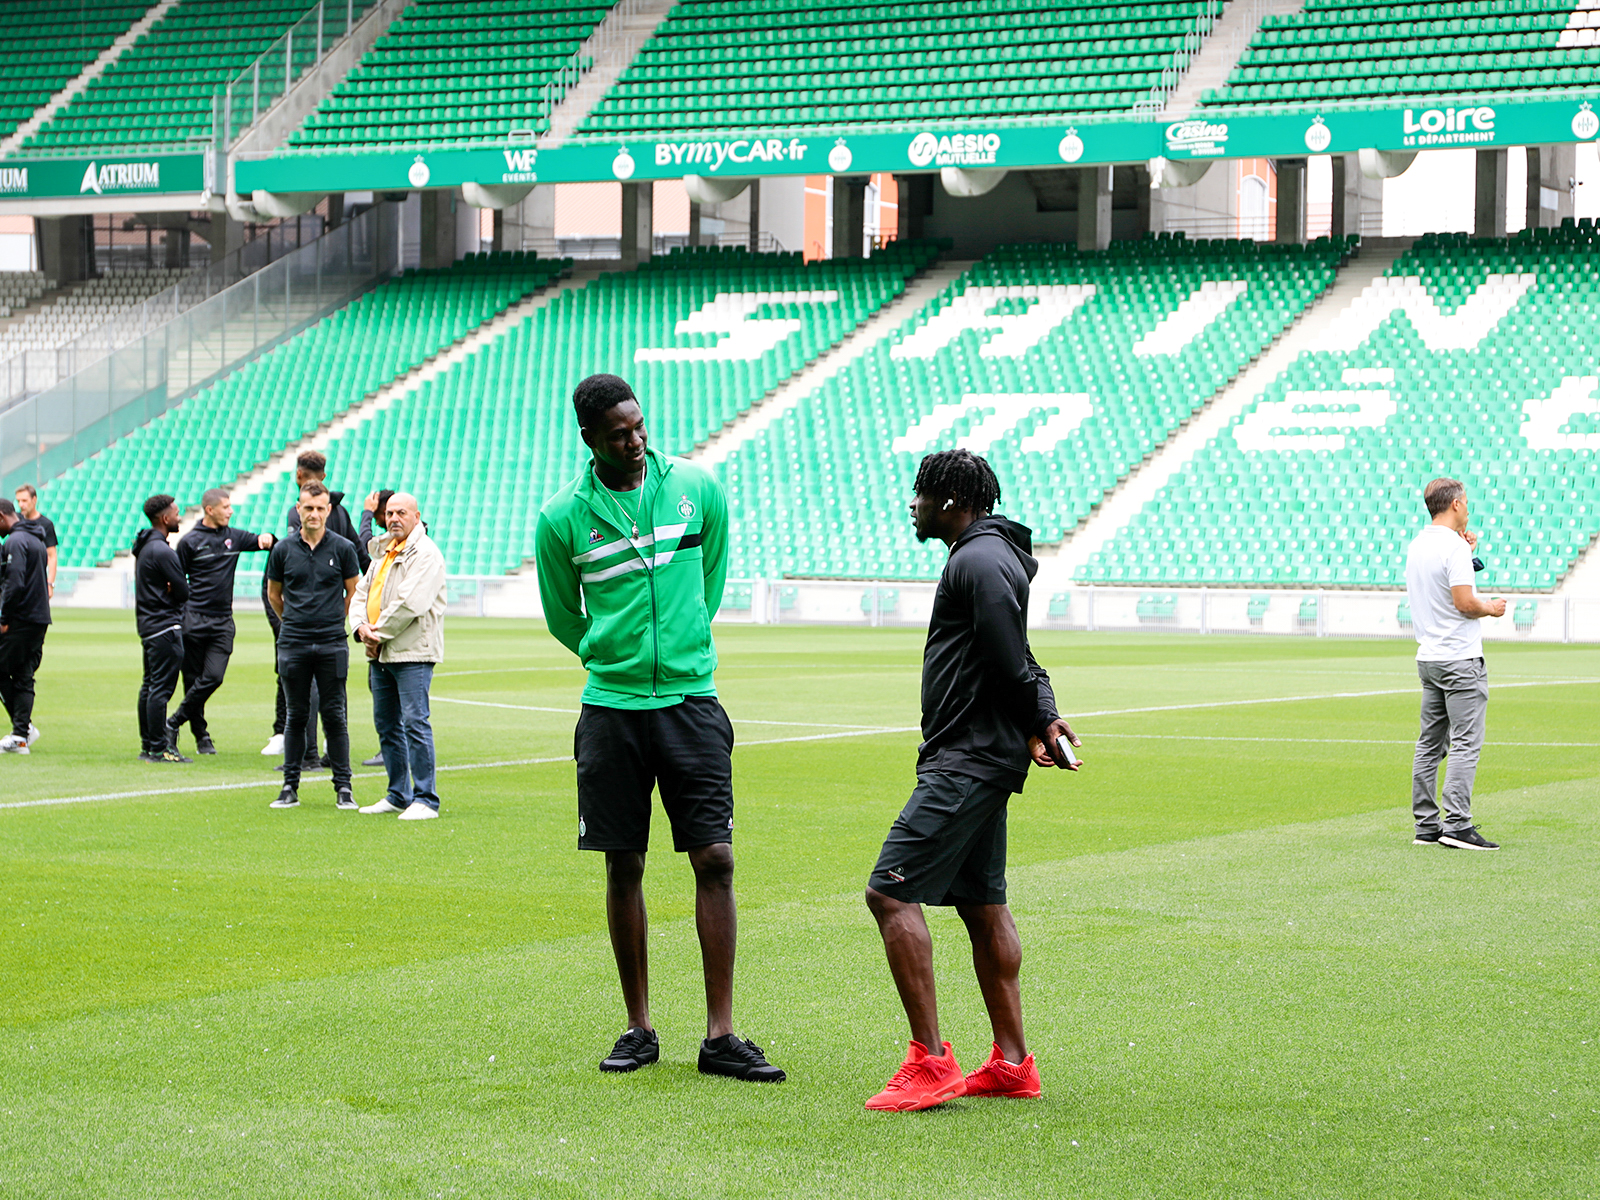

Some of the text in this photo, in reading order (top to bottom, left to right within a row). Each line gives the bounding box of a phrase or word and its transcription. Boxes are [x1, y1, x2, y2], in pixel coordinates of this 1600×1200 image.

[1166, 121, 1228, 141] Casino
[1403, 136, 1416, 146] LE
[502, 149, 538, 172] WF
[935, 151, 996, 166] MUTUELLE
[98, 162, 159, 185] ATRIUM
[502, 172, 538, 183] EVENTS
